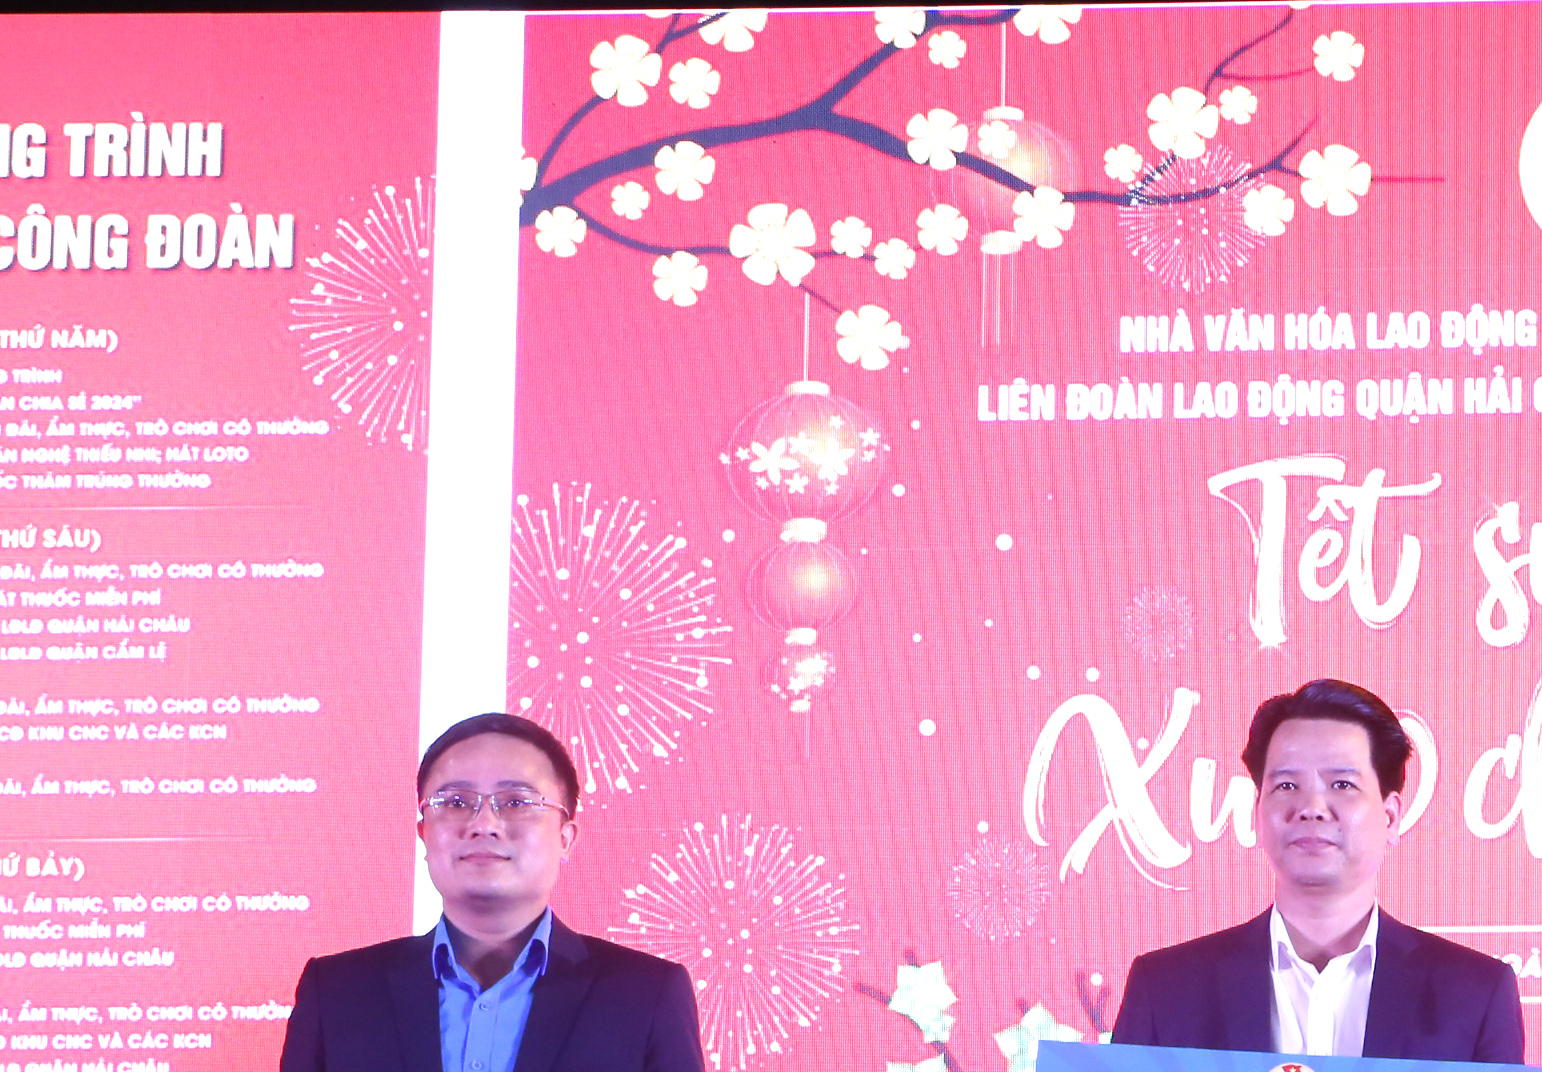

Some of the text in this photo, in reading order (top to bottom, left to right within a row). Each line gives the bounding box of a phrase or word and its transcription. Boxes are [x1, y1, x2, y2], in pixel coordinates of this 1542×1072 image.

[64, 110, 224, 178] TRÌNH
[144, 202, 294, 270] ĐOÀN
[51, 325, 118, 353] NĂM)
[1121, 309, 1192, 352] NHÀ
[1204, 308, 1274, 351] VĂN
[1367, 312, 1430, 348] LAO
[1441, 304, 1536, 355] ĐỘNG
[979, 378, 1054, 420] LIÊN
[1067, 377, 1162, 419] ĐOÀN
[1174, 382, 1238, 418] LAO
[1248, 374, 1344, 424] ĐỘNG
[1357, 373, 1452, 423] QUẬN
[1465, 366, 1521, 413] HẢI
[1208, 452, 1442, 645] Tết
